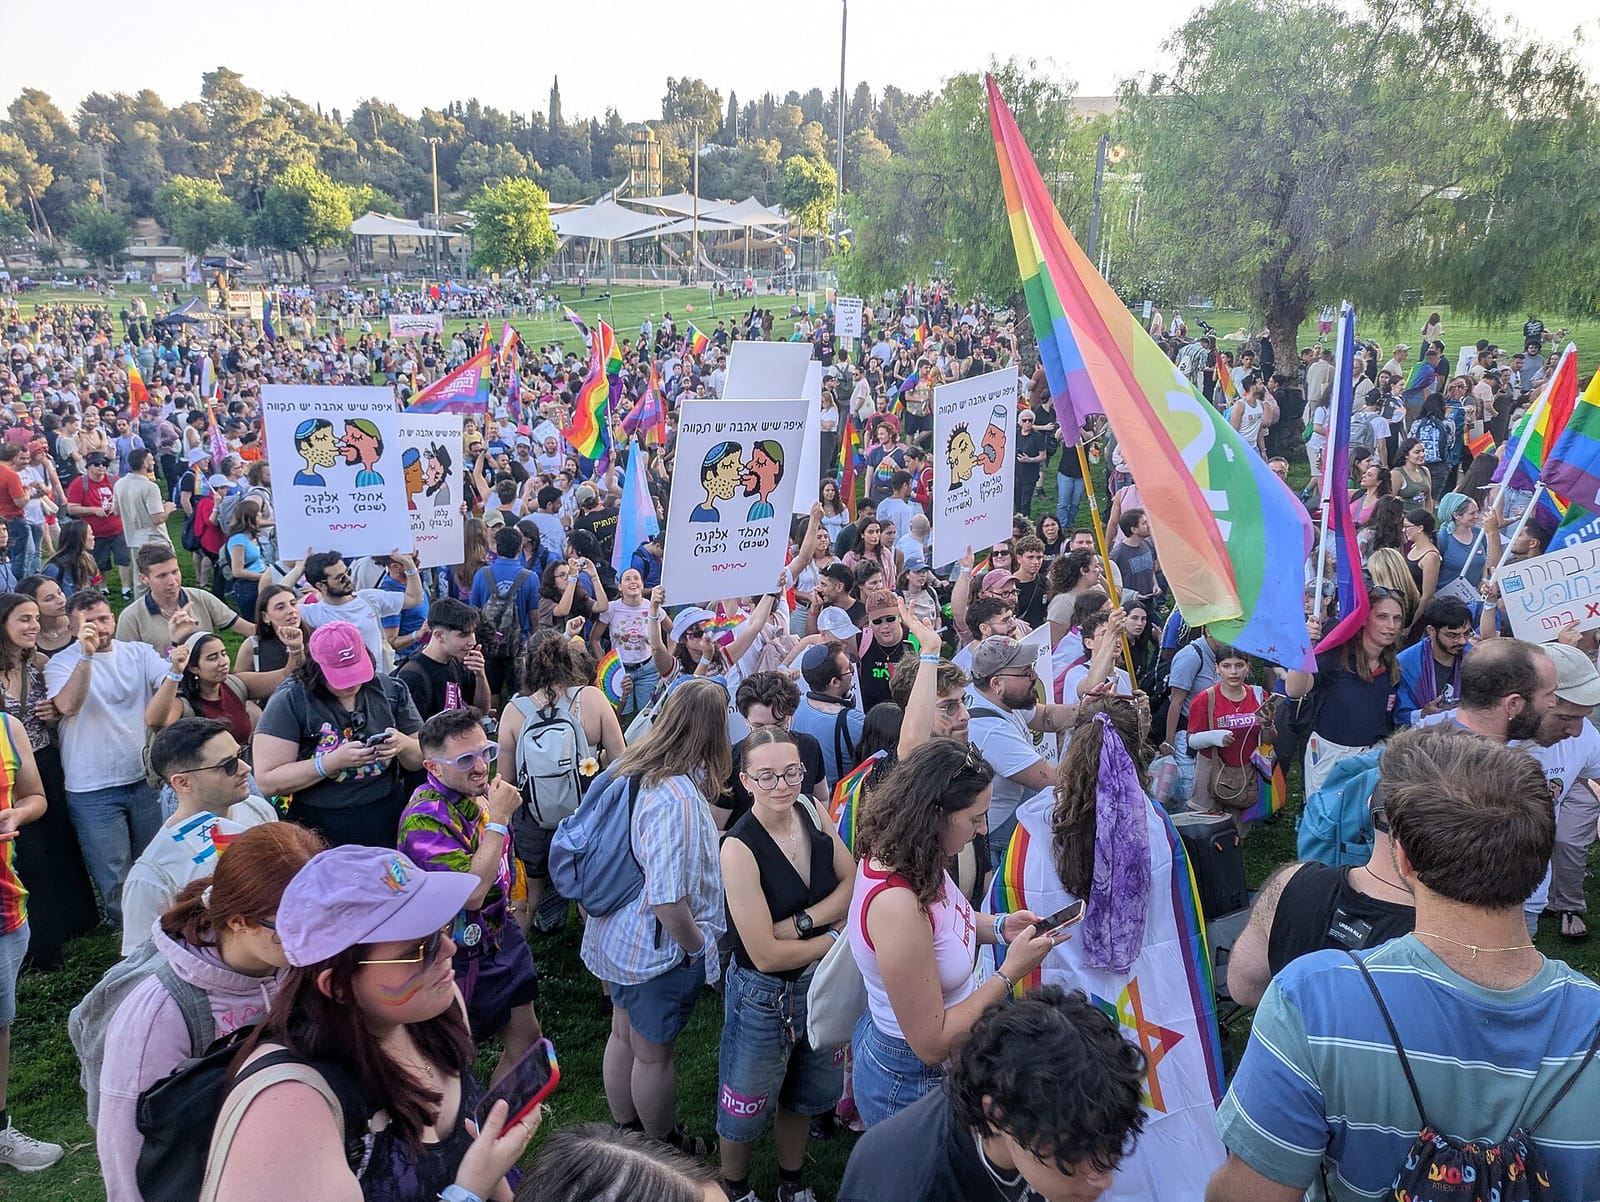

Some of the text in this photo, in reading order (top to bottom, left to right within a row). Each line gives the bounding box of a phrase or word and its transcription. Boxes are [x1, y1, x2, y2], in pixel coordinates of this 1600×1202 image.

[266, 402, 393, 412] איפה שיש אהבה יש תקווה
[938, 385, 1016, 415] איפה שיש אהבה יש תקווה
[406, 429, 415, 438] יש
[415, 429, 434, 438] אהבה
[435, 430, 449, 438] שיש
[449, 429, 461, 438] איפה
[682, 420, 804, 435] איפה שיש אהבה יש תקווה
[304, 490, 339, 506] אלקנה
[348, 491, 384, 502] אחמד
[304, 504, 341, 517] (יצהר)
[353, 502, 387, 514] (שכם)
[944, 496, 973, 517] (אשדוד)
[695, 527, 729, 545] אלקנה
[737, 525, 769, 538] אחמד
[693, 542, 727, 557] (יצהר)
[738, 537, 769, 552] (שכם)
[1520, 570, 1600, 614] חופש
[1541, 610, 1576, 631] בהם
[1549, 766, 1565, 775] איפה
[721, 1090, 769, 1114] לסבית
